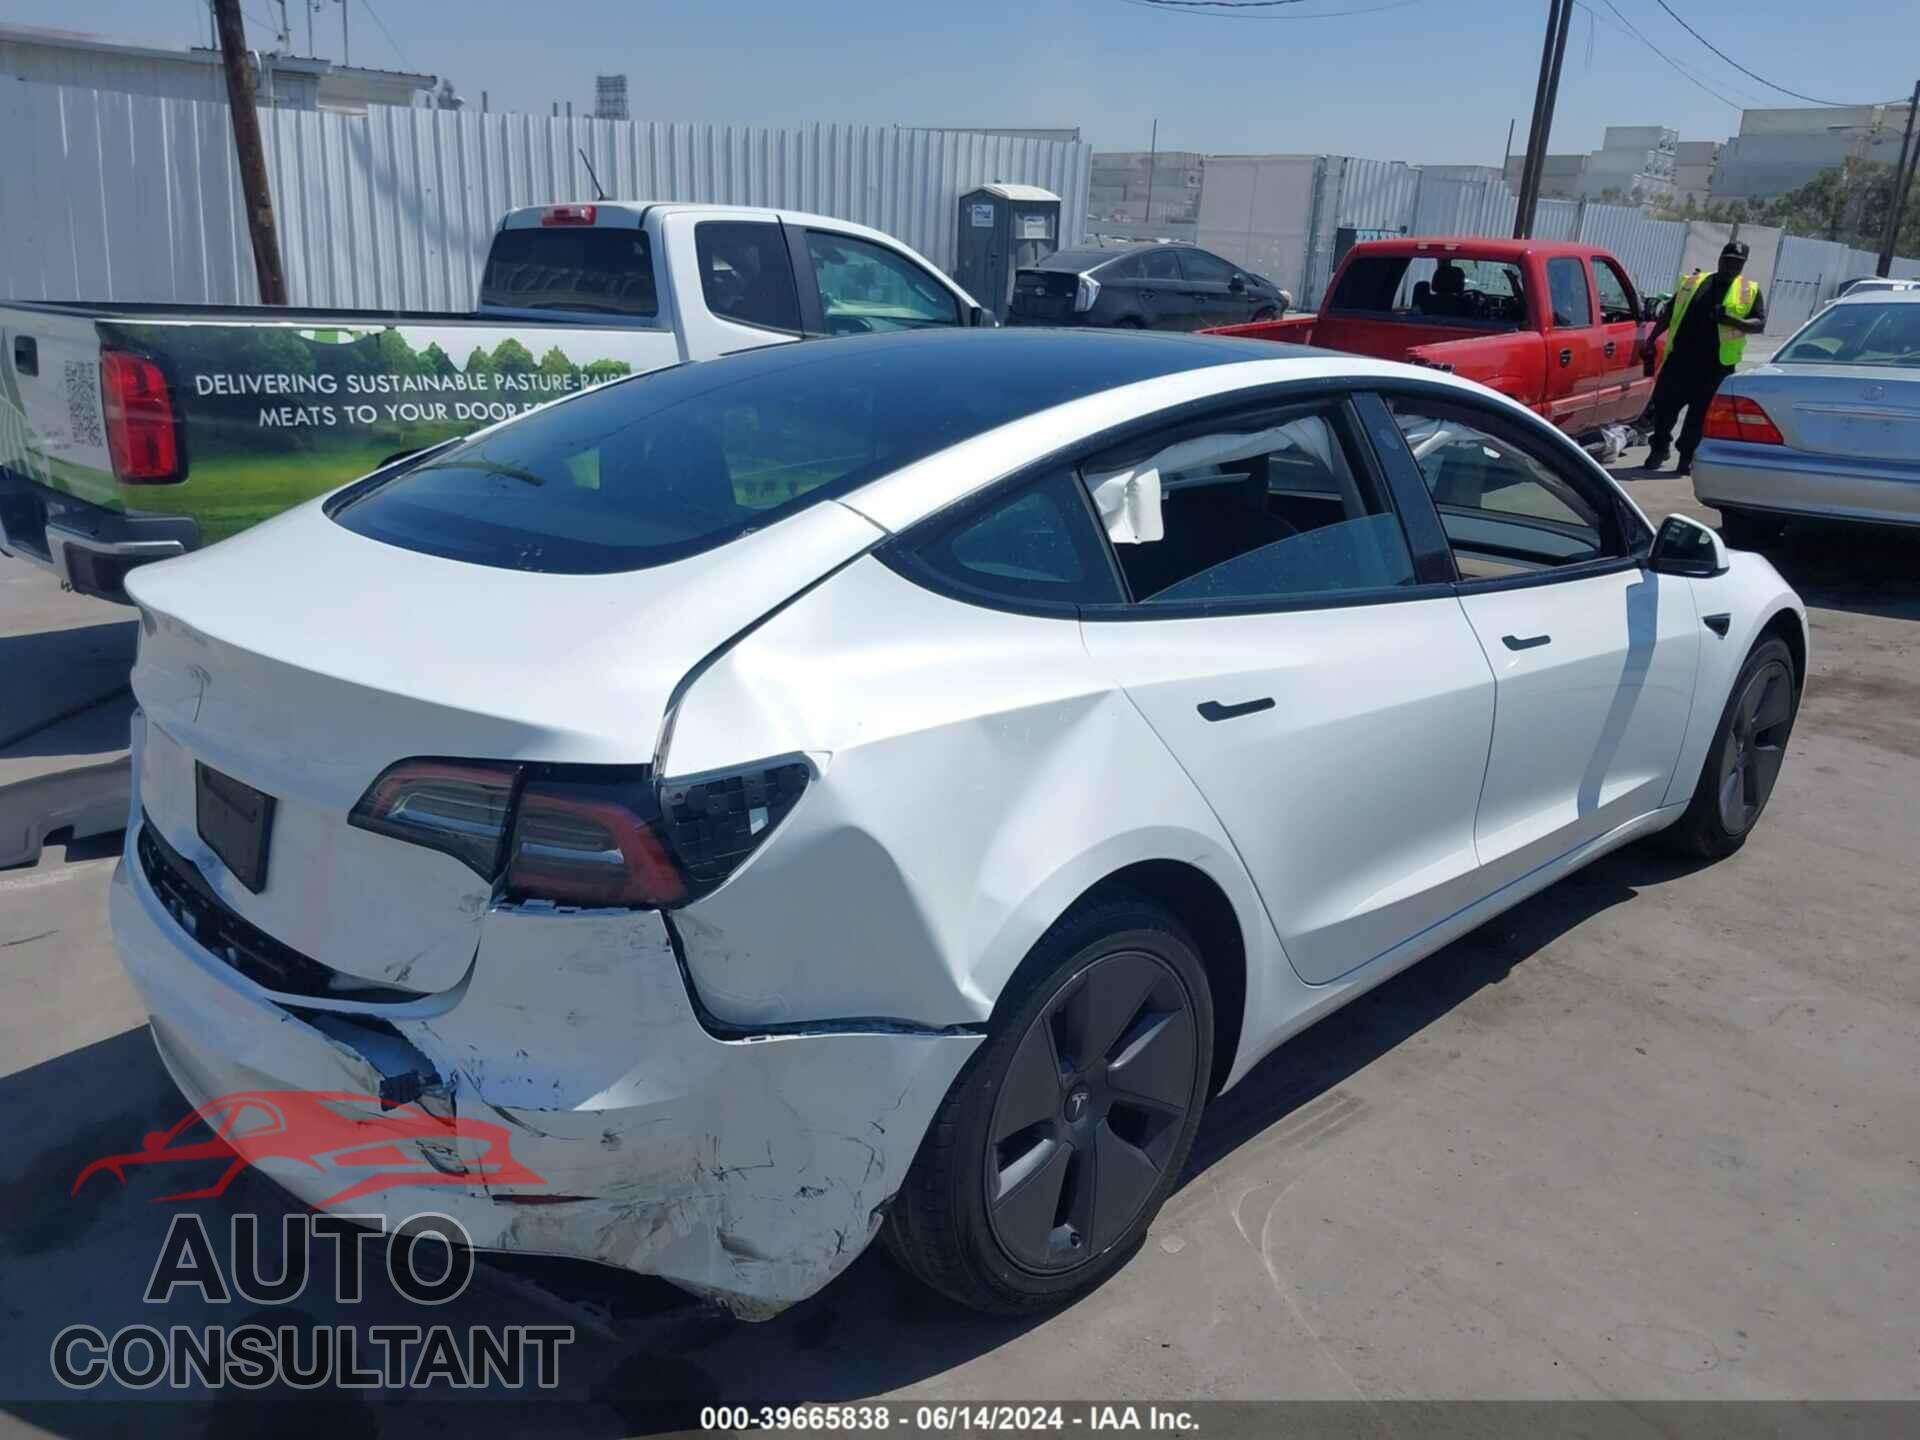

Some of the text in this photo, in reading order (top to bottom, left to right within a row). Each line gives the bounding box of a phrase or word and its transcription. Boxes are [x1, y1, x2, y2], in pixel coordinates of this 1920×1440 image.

[195, 374, 338, 396] DELIVERING
[346, 373, 488, 393] SUSTAINABLE
[259, 406, 337, 427] MEATS
[343, 405, 377, 425] TO
[384, 403, 448, 422] YOUR
[455, 402, 517, 420] DOOR
